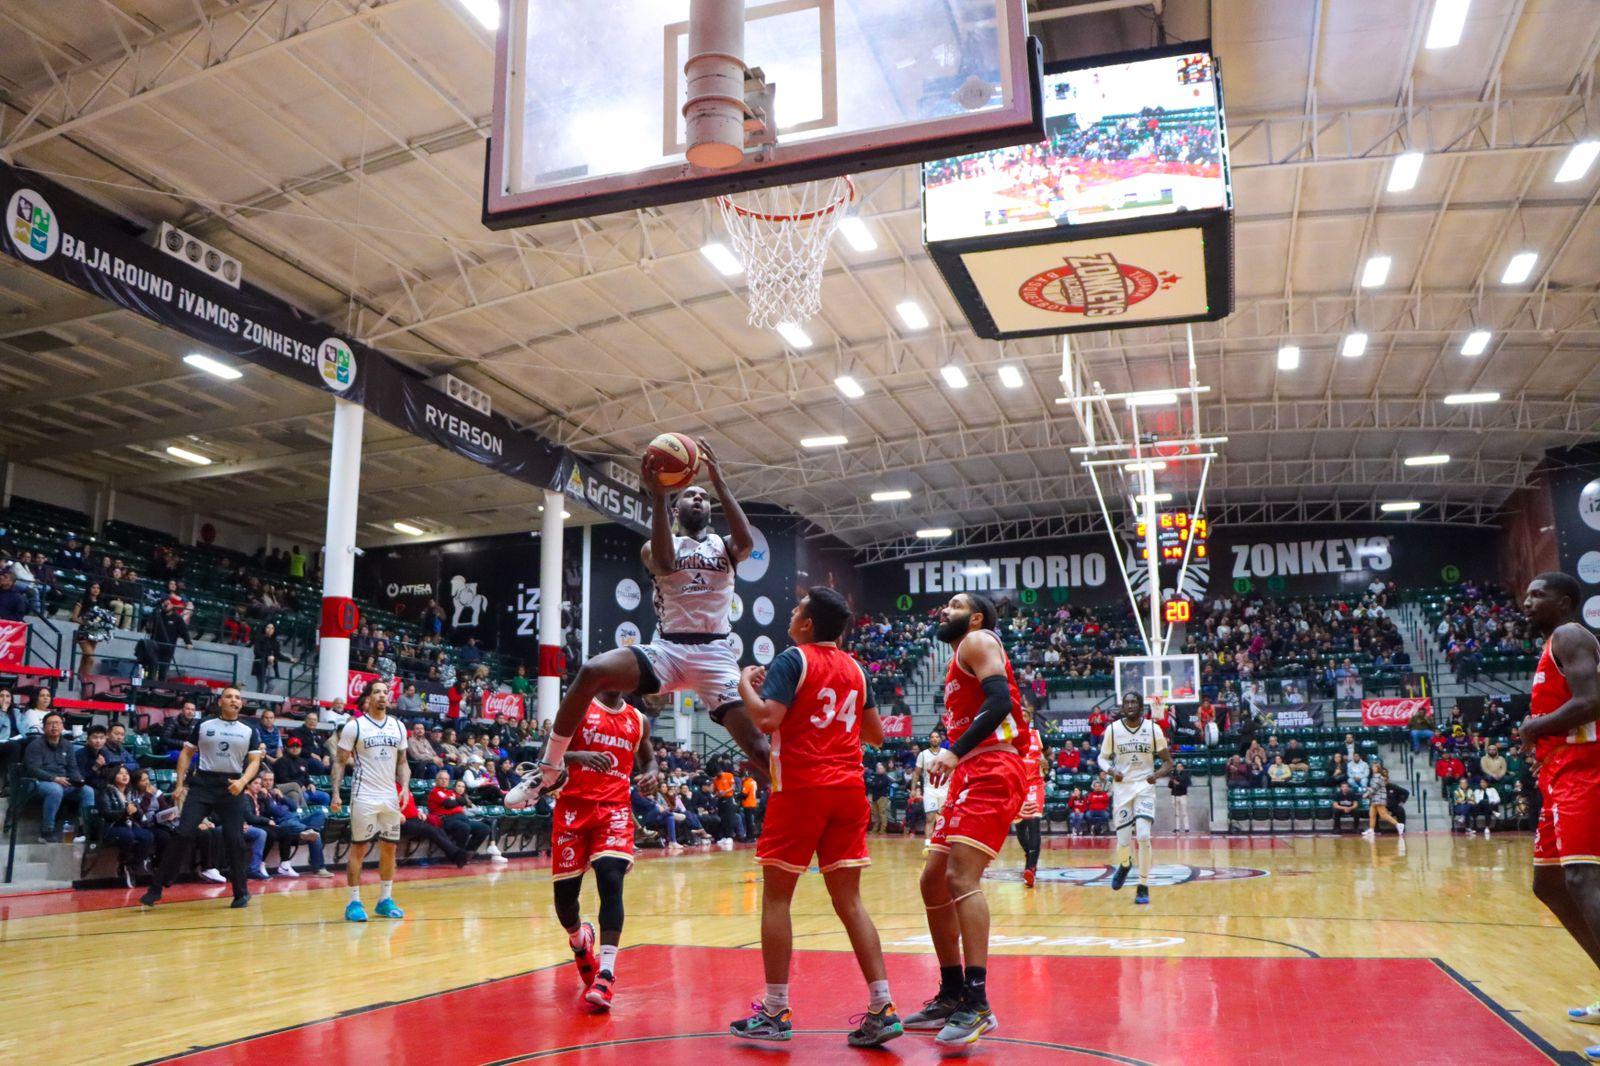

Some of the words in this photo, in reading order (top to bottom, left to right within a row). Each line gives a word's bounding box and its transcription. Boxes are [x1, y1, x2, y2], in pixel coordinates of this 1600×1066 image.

[1065, 253, 1127, 317] ZONKEYS
[178, 287, 240, 334] ¡VAMOS
[243, 317, 317, 367] ZONKEYS!
[425, 403, 503, 456] RYERSON
[674, 554, 729, 574] ONKEYS
[1231, 535, 1393, 578] ZONKEYS
[400, 583, 432, 595] ATISA
[904, 552, 1107, 594] TERRITORIO
[1165, 601, 1190, 621] 20
[810, 687, 858, 733] 34
[1366, 699, 1427, 721] Coca-Col
[363, 735, 401, 749] ZONKEYS
[1117, 742, 1151, 754] ZONKEYS
